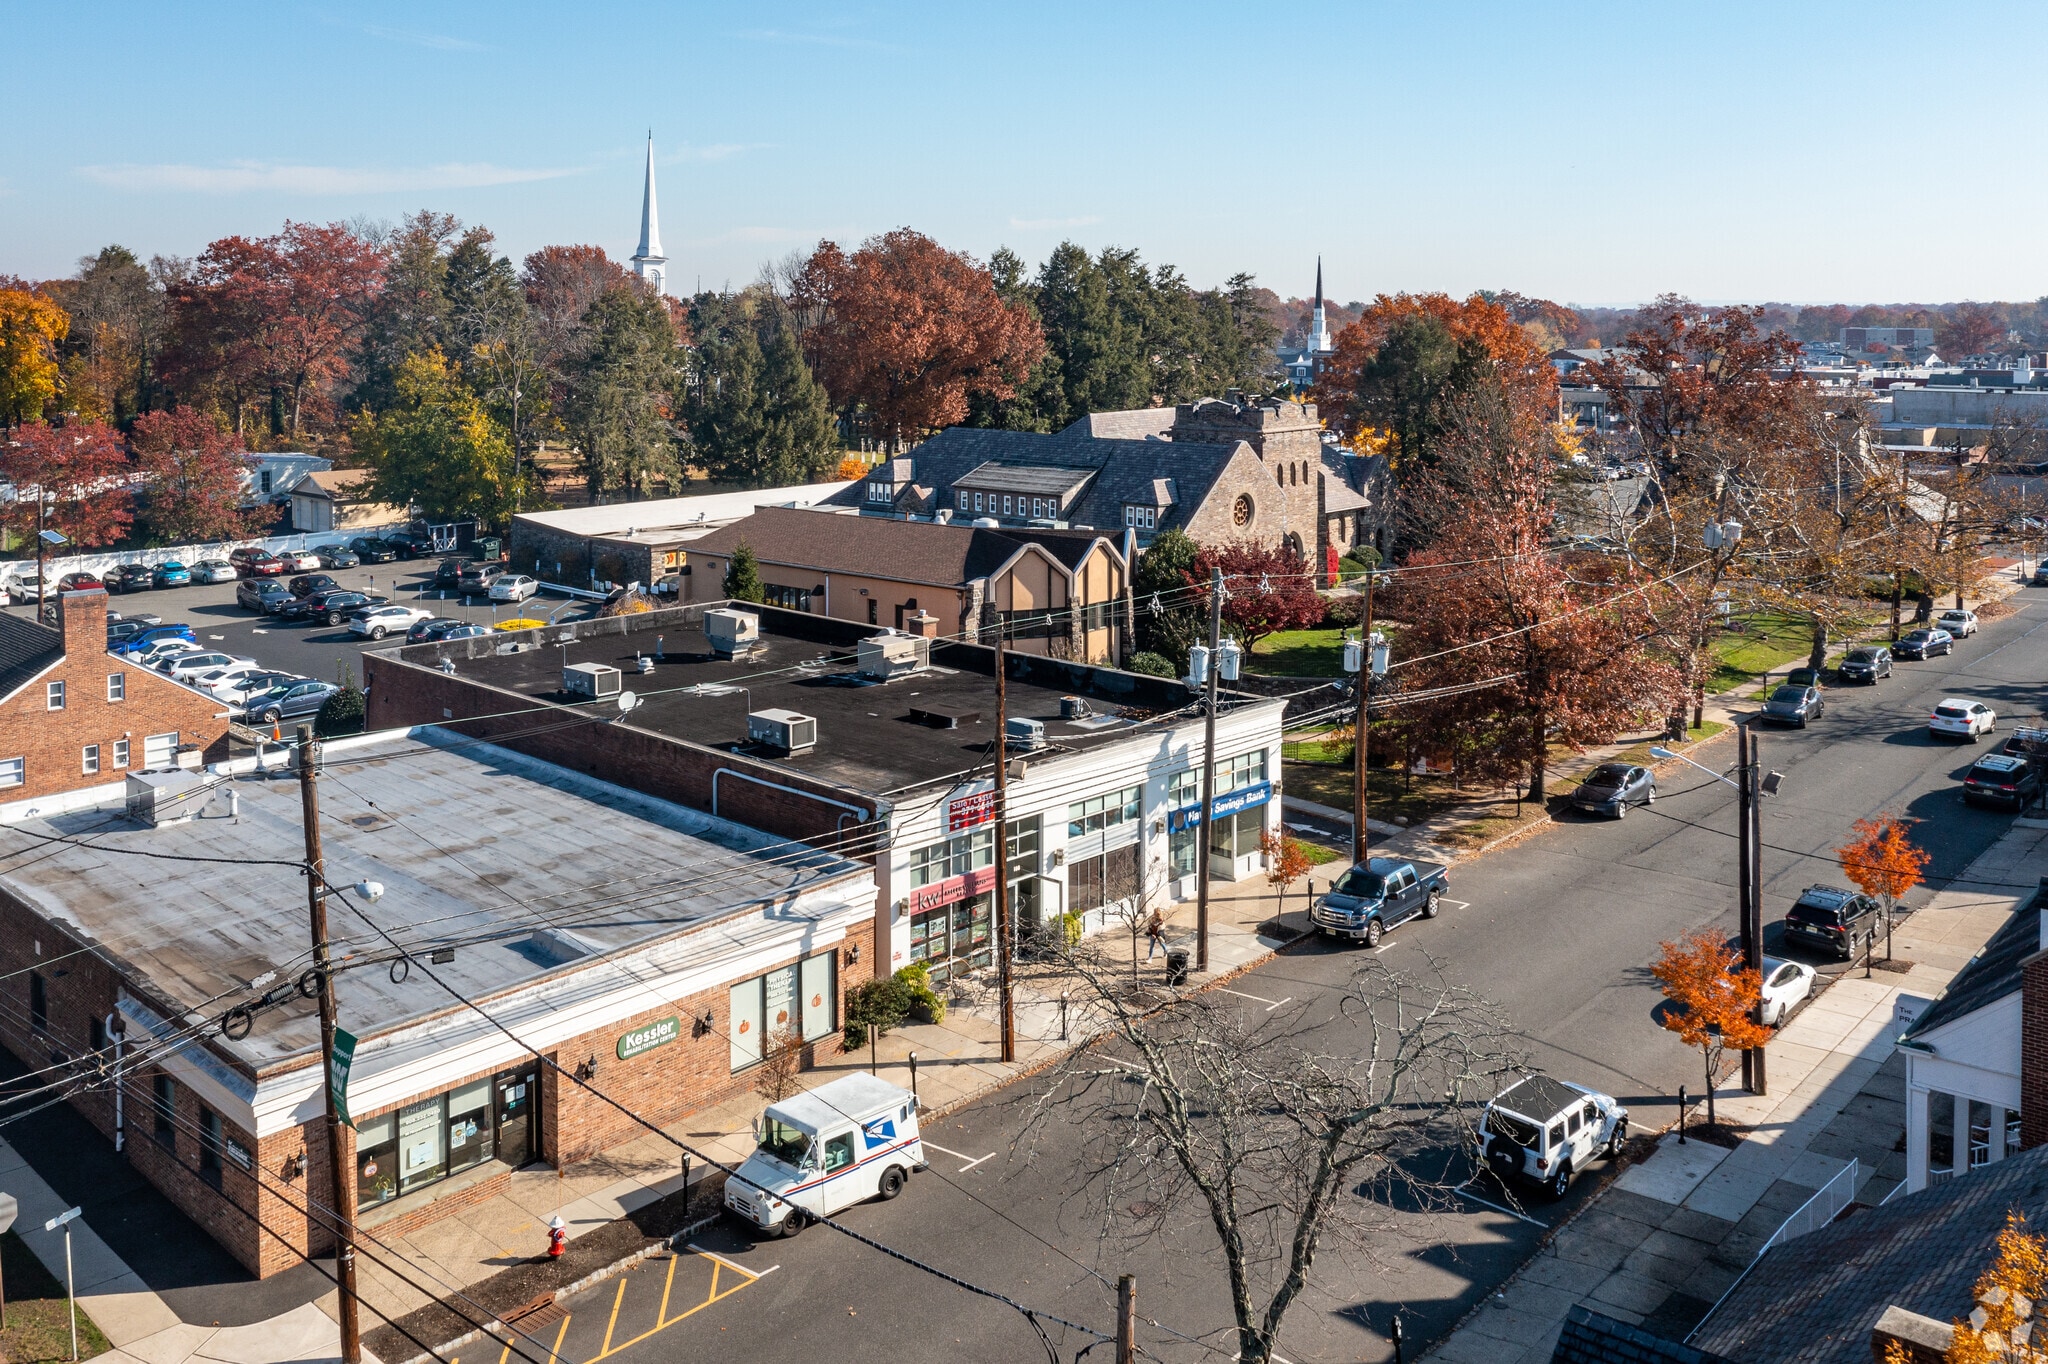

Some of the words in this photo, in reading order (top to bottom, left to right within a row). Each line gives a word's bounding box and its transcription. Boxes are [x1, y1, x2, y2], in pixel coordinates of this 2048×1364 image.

[1214, 797, 1244, 814] Savings
[1246, 788, 1266, 804] Bank
[623, 1038, 660, 1057] REHABILITATION
[659, 1031, 677, 1044] CENTER
[625, 1021, 674, 1049] Kessler
[405, 1097, 441, 1116] THERAPY
